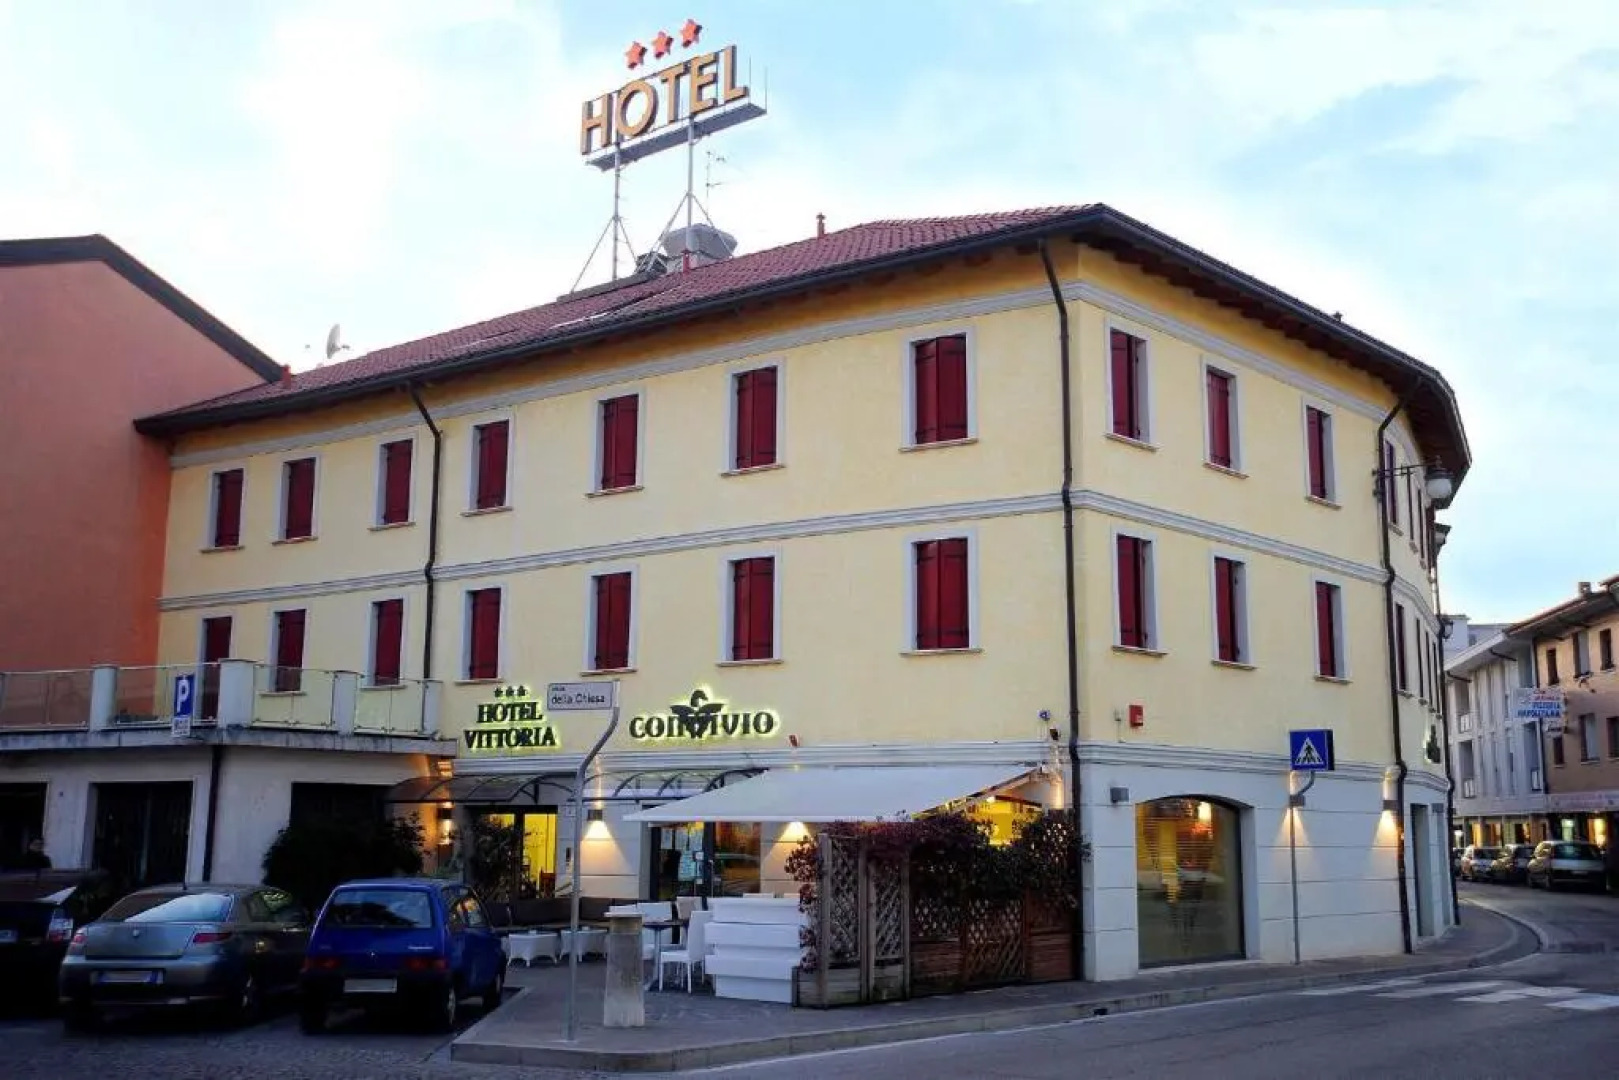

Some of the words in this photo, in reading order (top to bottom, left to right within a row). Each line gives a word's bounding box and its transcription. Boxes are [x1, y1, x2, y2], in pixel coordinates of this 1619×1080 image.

[581, 45, 749, 155] HOTEL
[177, 679, 189, 712] P
[552, 693, 573, 704] della
[477, 702, 544, 723] HOTEL
[463, 727, 556, 748] VITTORIA
